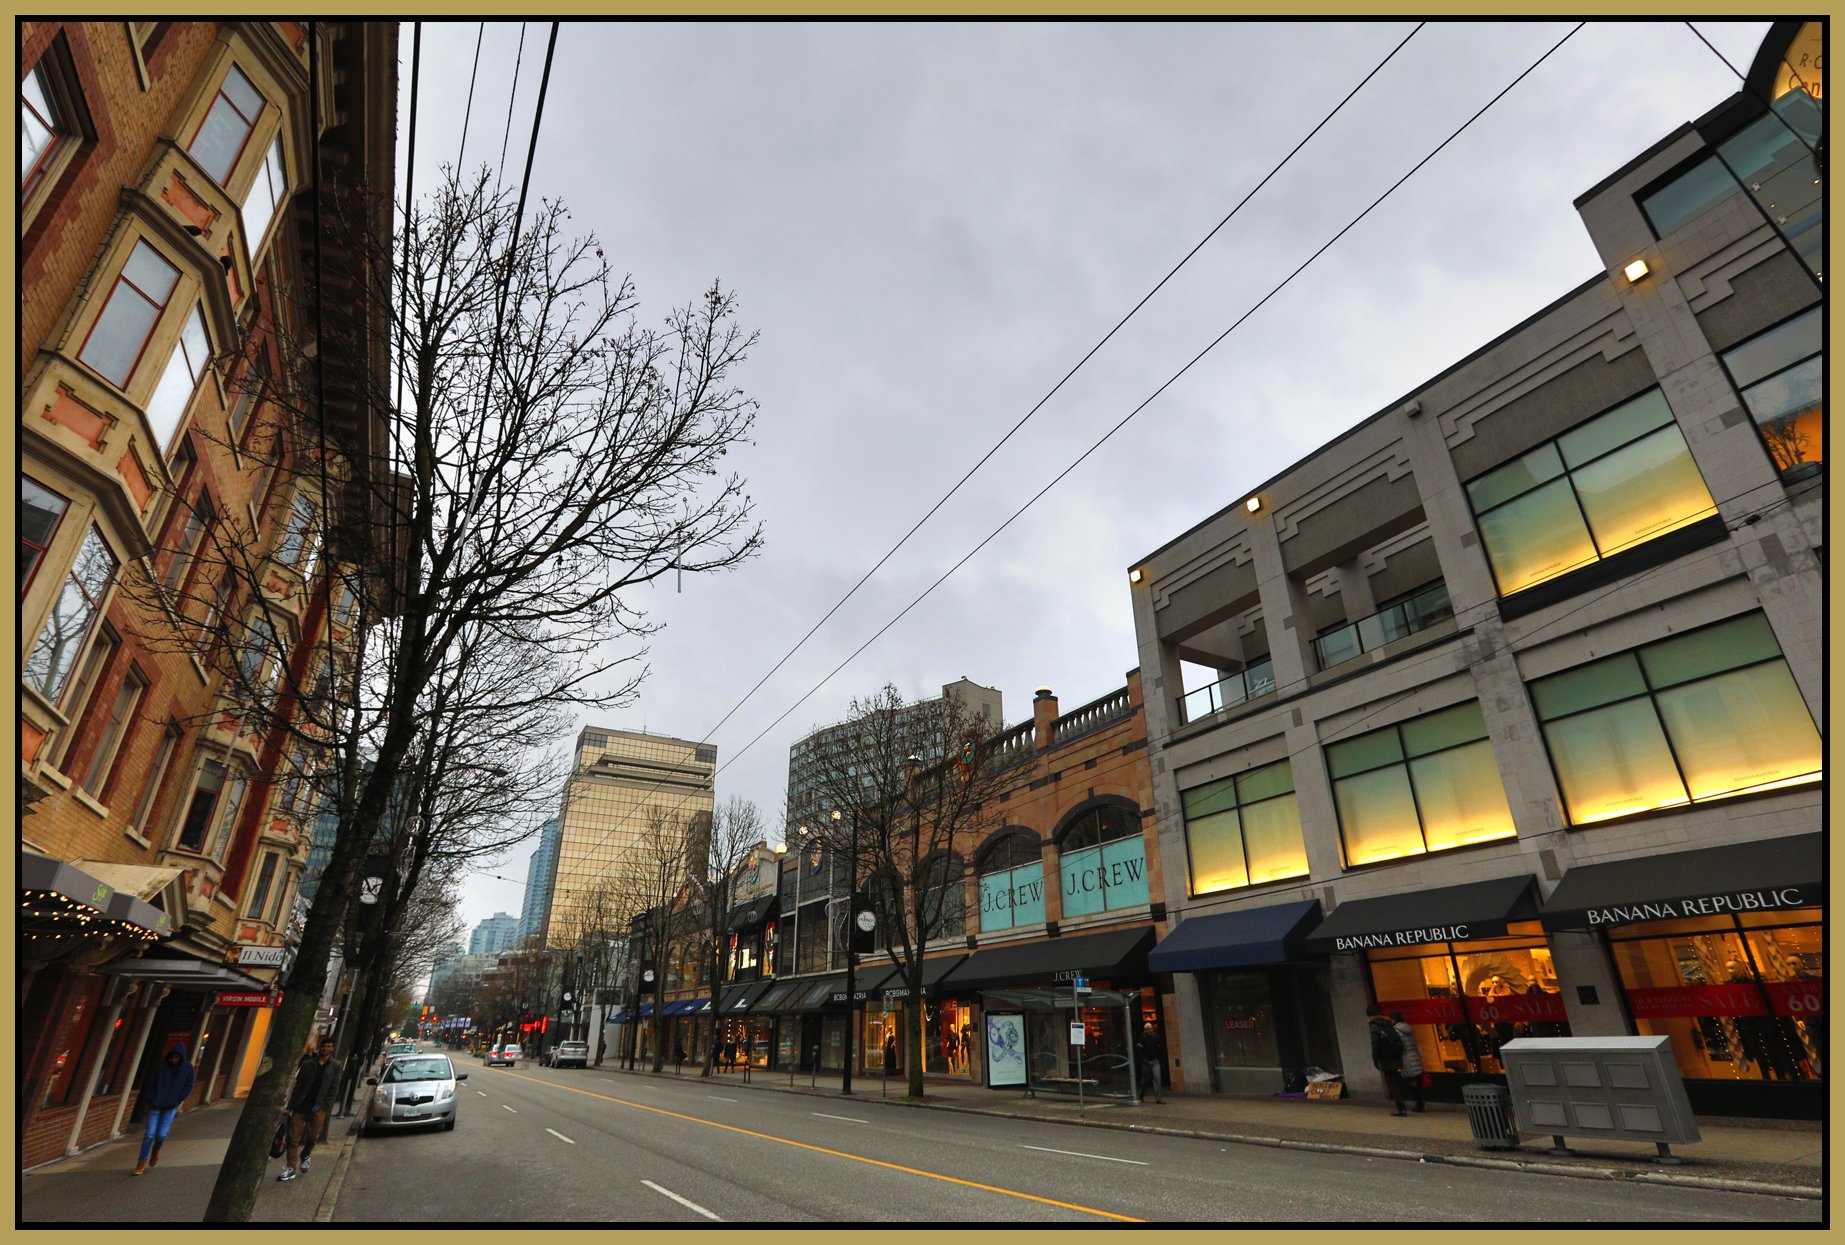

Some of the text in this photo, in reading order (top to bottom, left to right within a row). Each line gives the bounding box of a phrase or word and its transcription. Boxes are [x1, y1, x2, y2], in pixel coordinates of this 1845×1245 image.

[1066, 857, 1144, 896] J.CREW
[983, 881, 1044, 913] J.CREW
[1587, 888, 1803, 925] BANANA REPUBLIC
[1336, 925, 1469, 950] BANANA REPUBLIC
[242, 950, 283, 961] Il Nido
[1053, 969, 1082, 982] J.CREW
[1787, 994, 1821, 1011] 60
[1480, 1006, 1500, 1020] 60
[1225, 1019, 1254, 1029] LEASED
